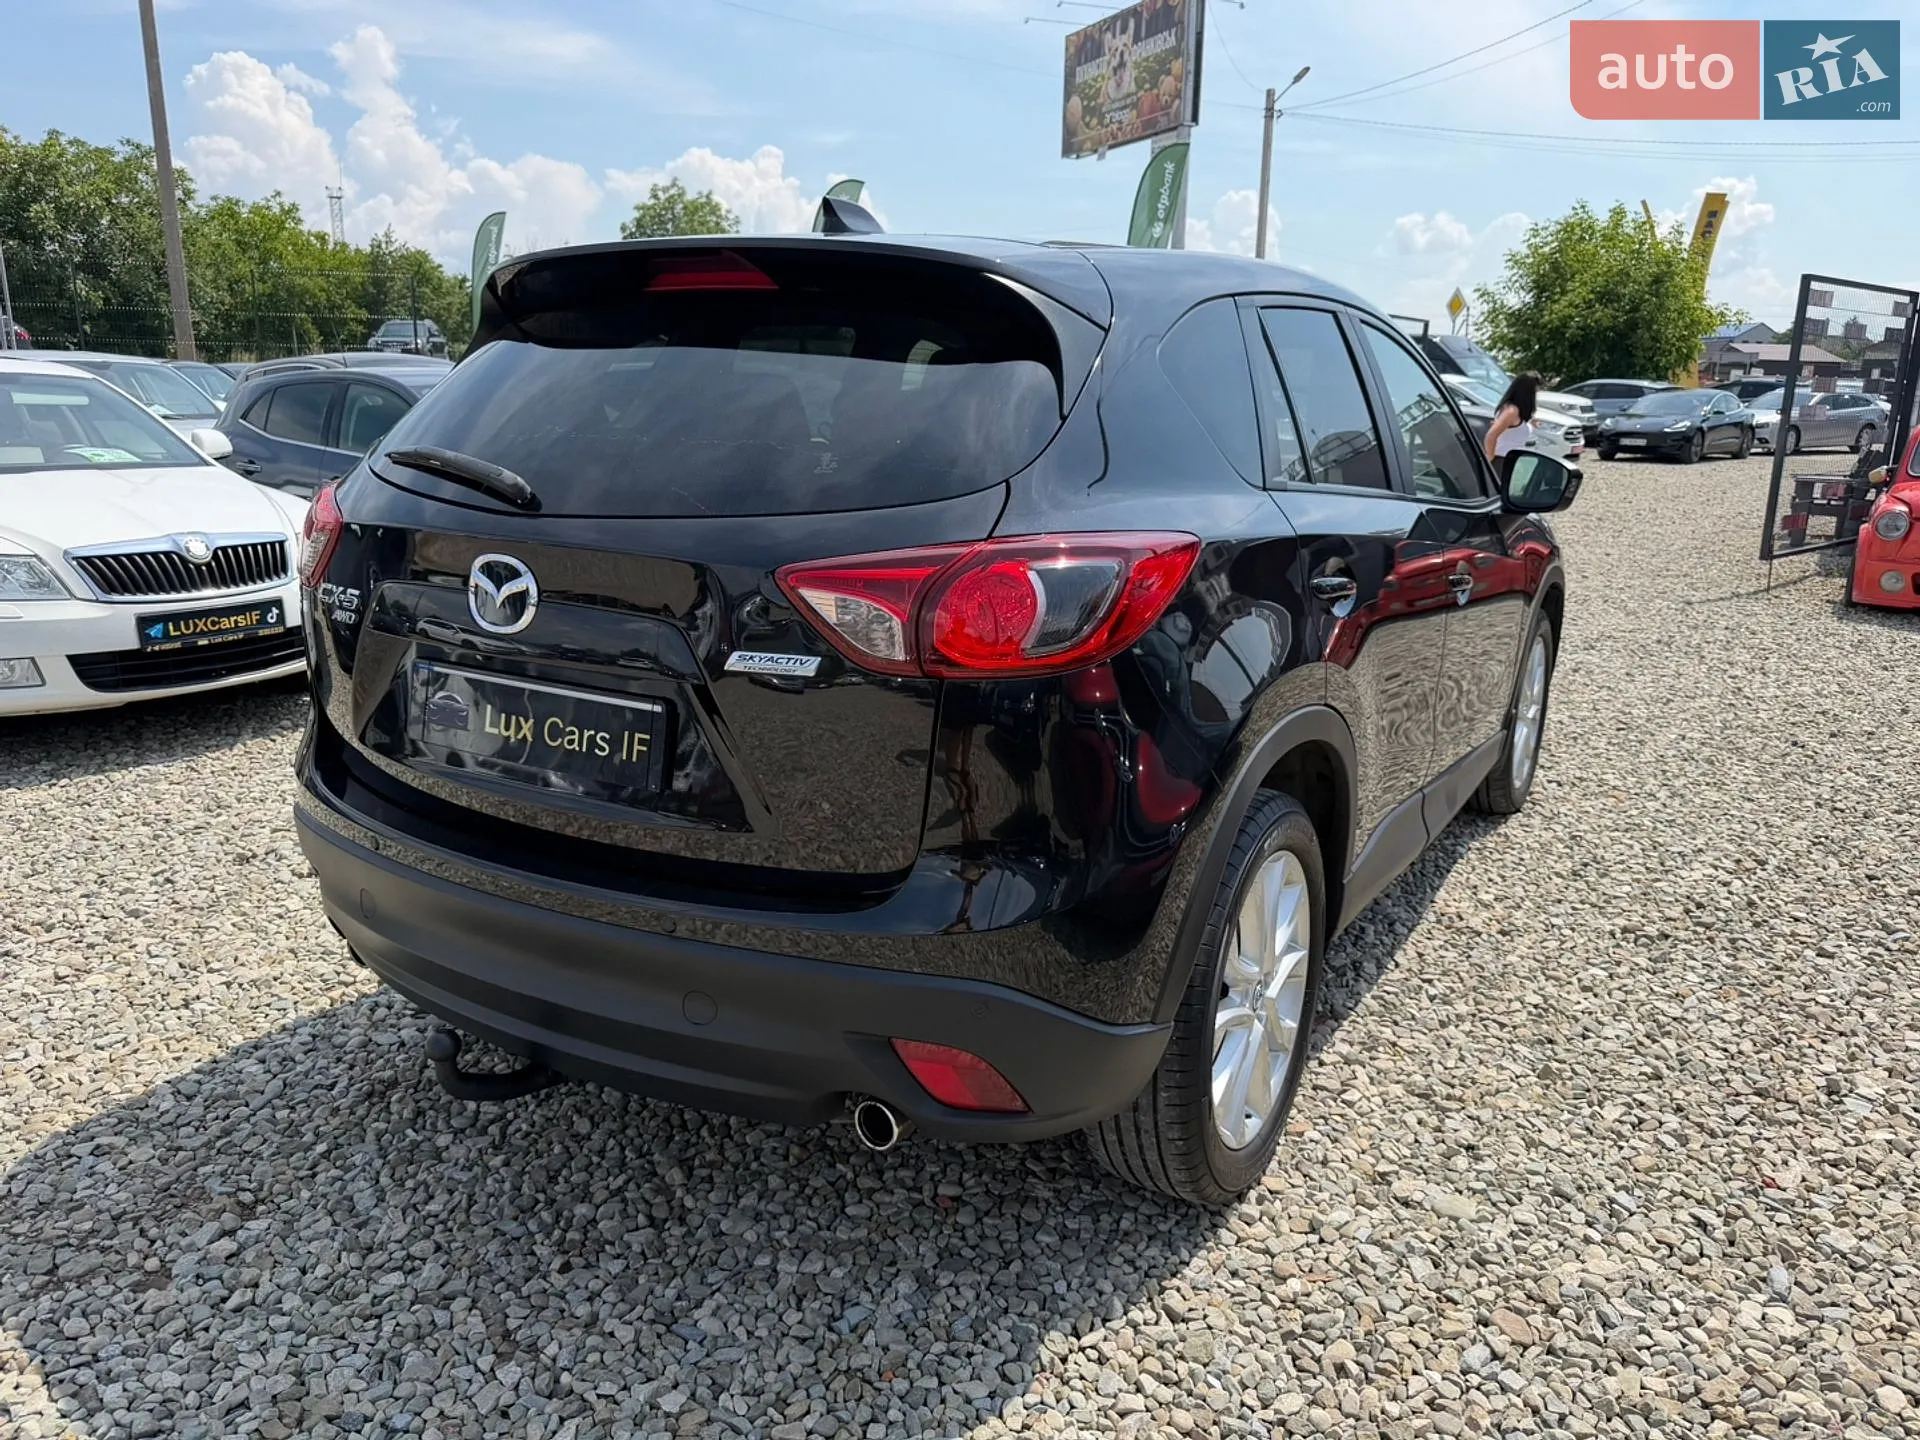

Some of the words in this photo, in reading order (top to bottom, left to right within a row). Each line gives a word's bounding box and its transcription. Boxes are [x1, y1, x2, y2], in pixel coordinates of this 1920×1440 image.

[319, 582, 361, 610] CX-5
[168, 610, 261, 637] LUXCarsIF
[331, 609, 356, 624] AWD
[735, 653, 812, 666] SKYACTIV
[743, 665, 797, 674] TECHNOLOGY
[484, 704, 535, 742] Lux
[543, 717, 611, 756] Cars
[621, 731, 651, 762] IF
